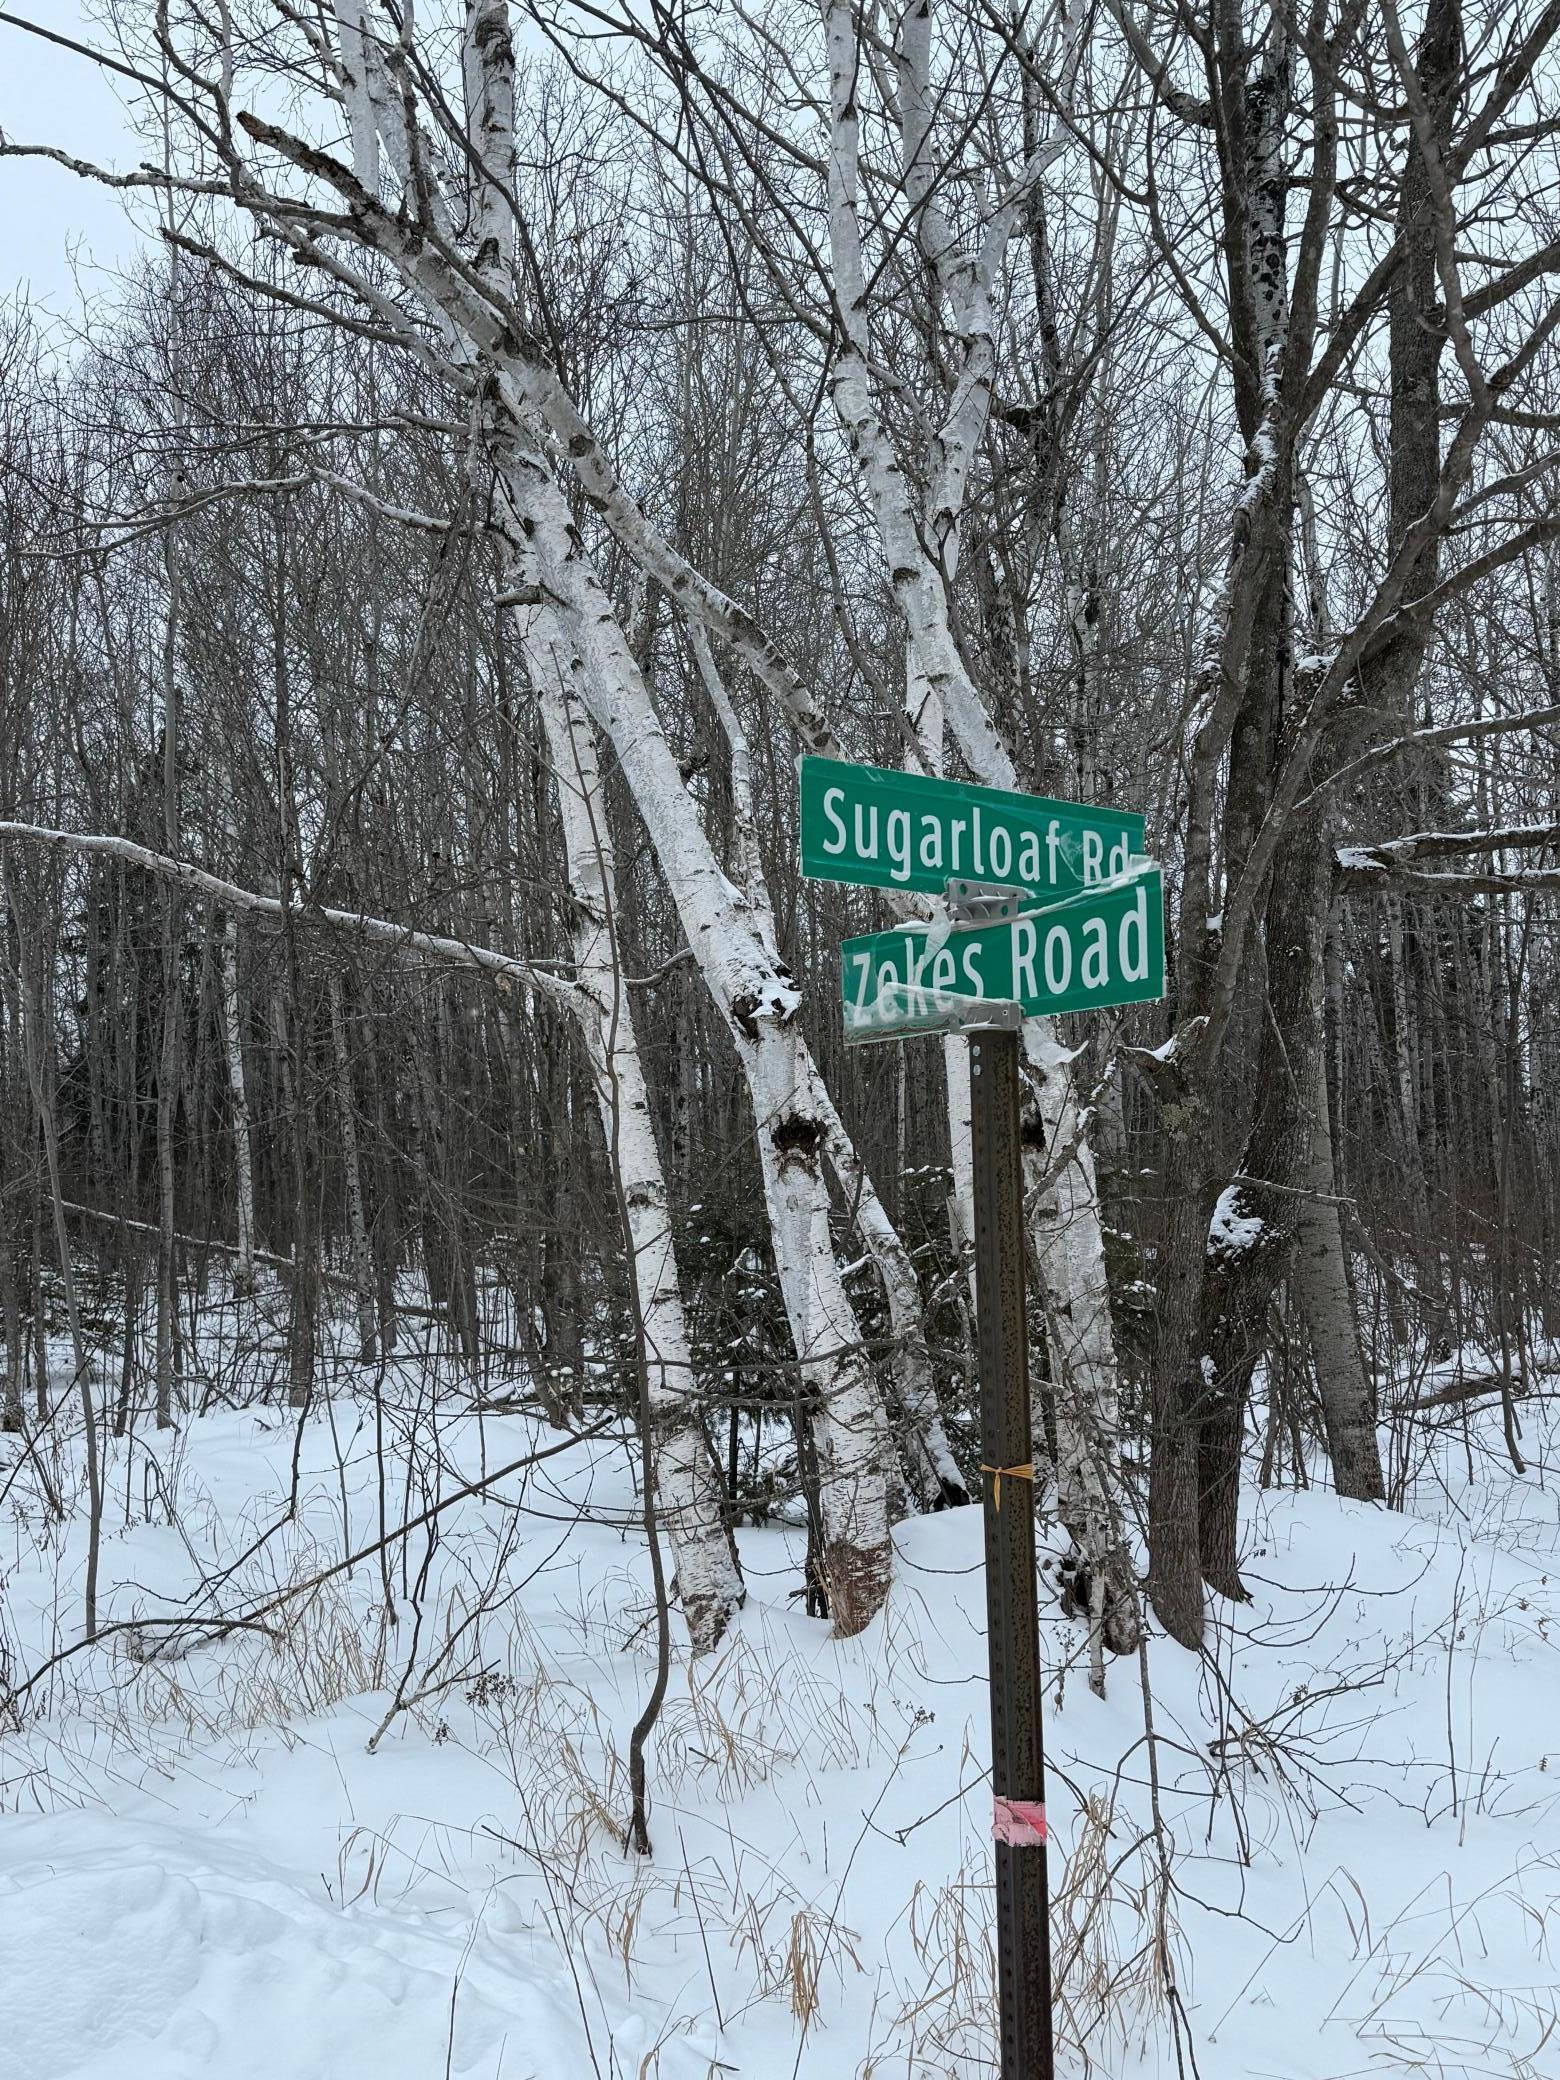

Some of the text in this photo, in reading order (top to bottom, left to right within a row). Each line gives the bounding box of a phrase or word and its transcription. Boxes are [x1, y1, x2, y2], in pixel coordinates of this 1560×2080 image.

[822, 787, 1129, 886] Sugarloaf Rd
[852, 886, 1149, 1027] Zekes Road
